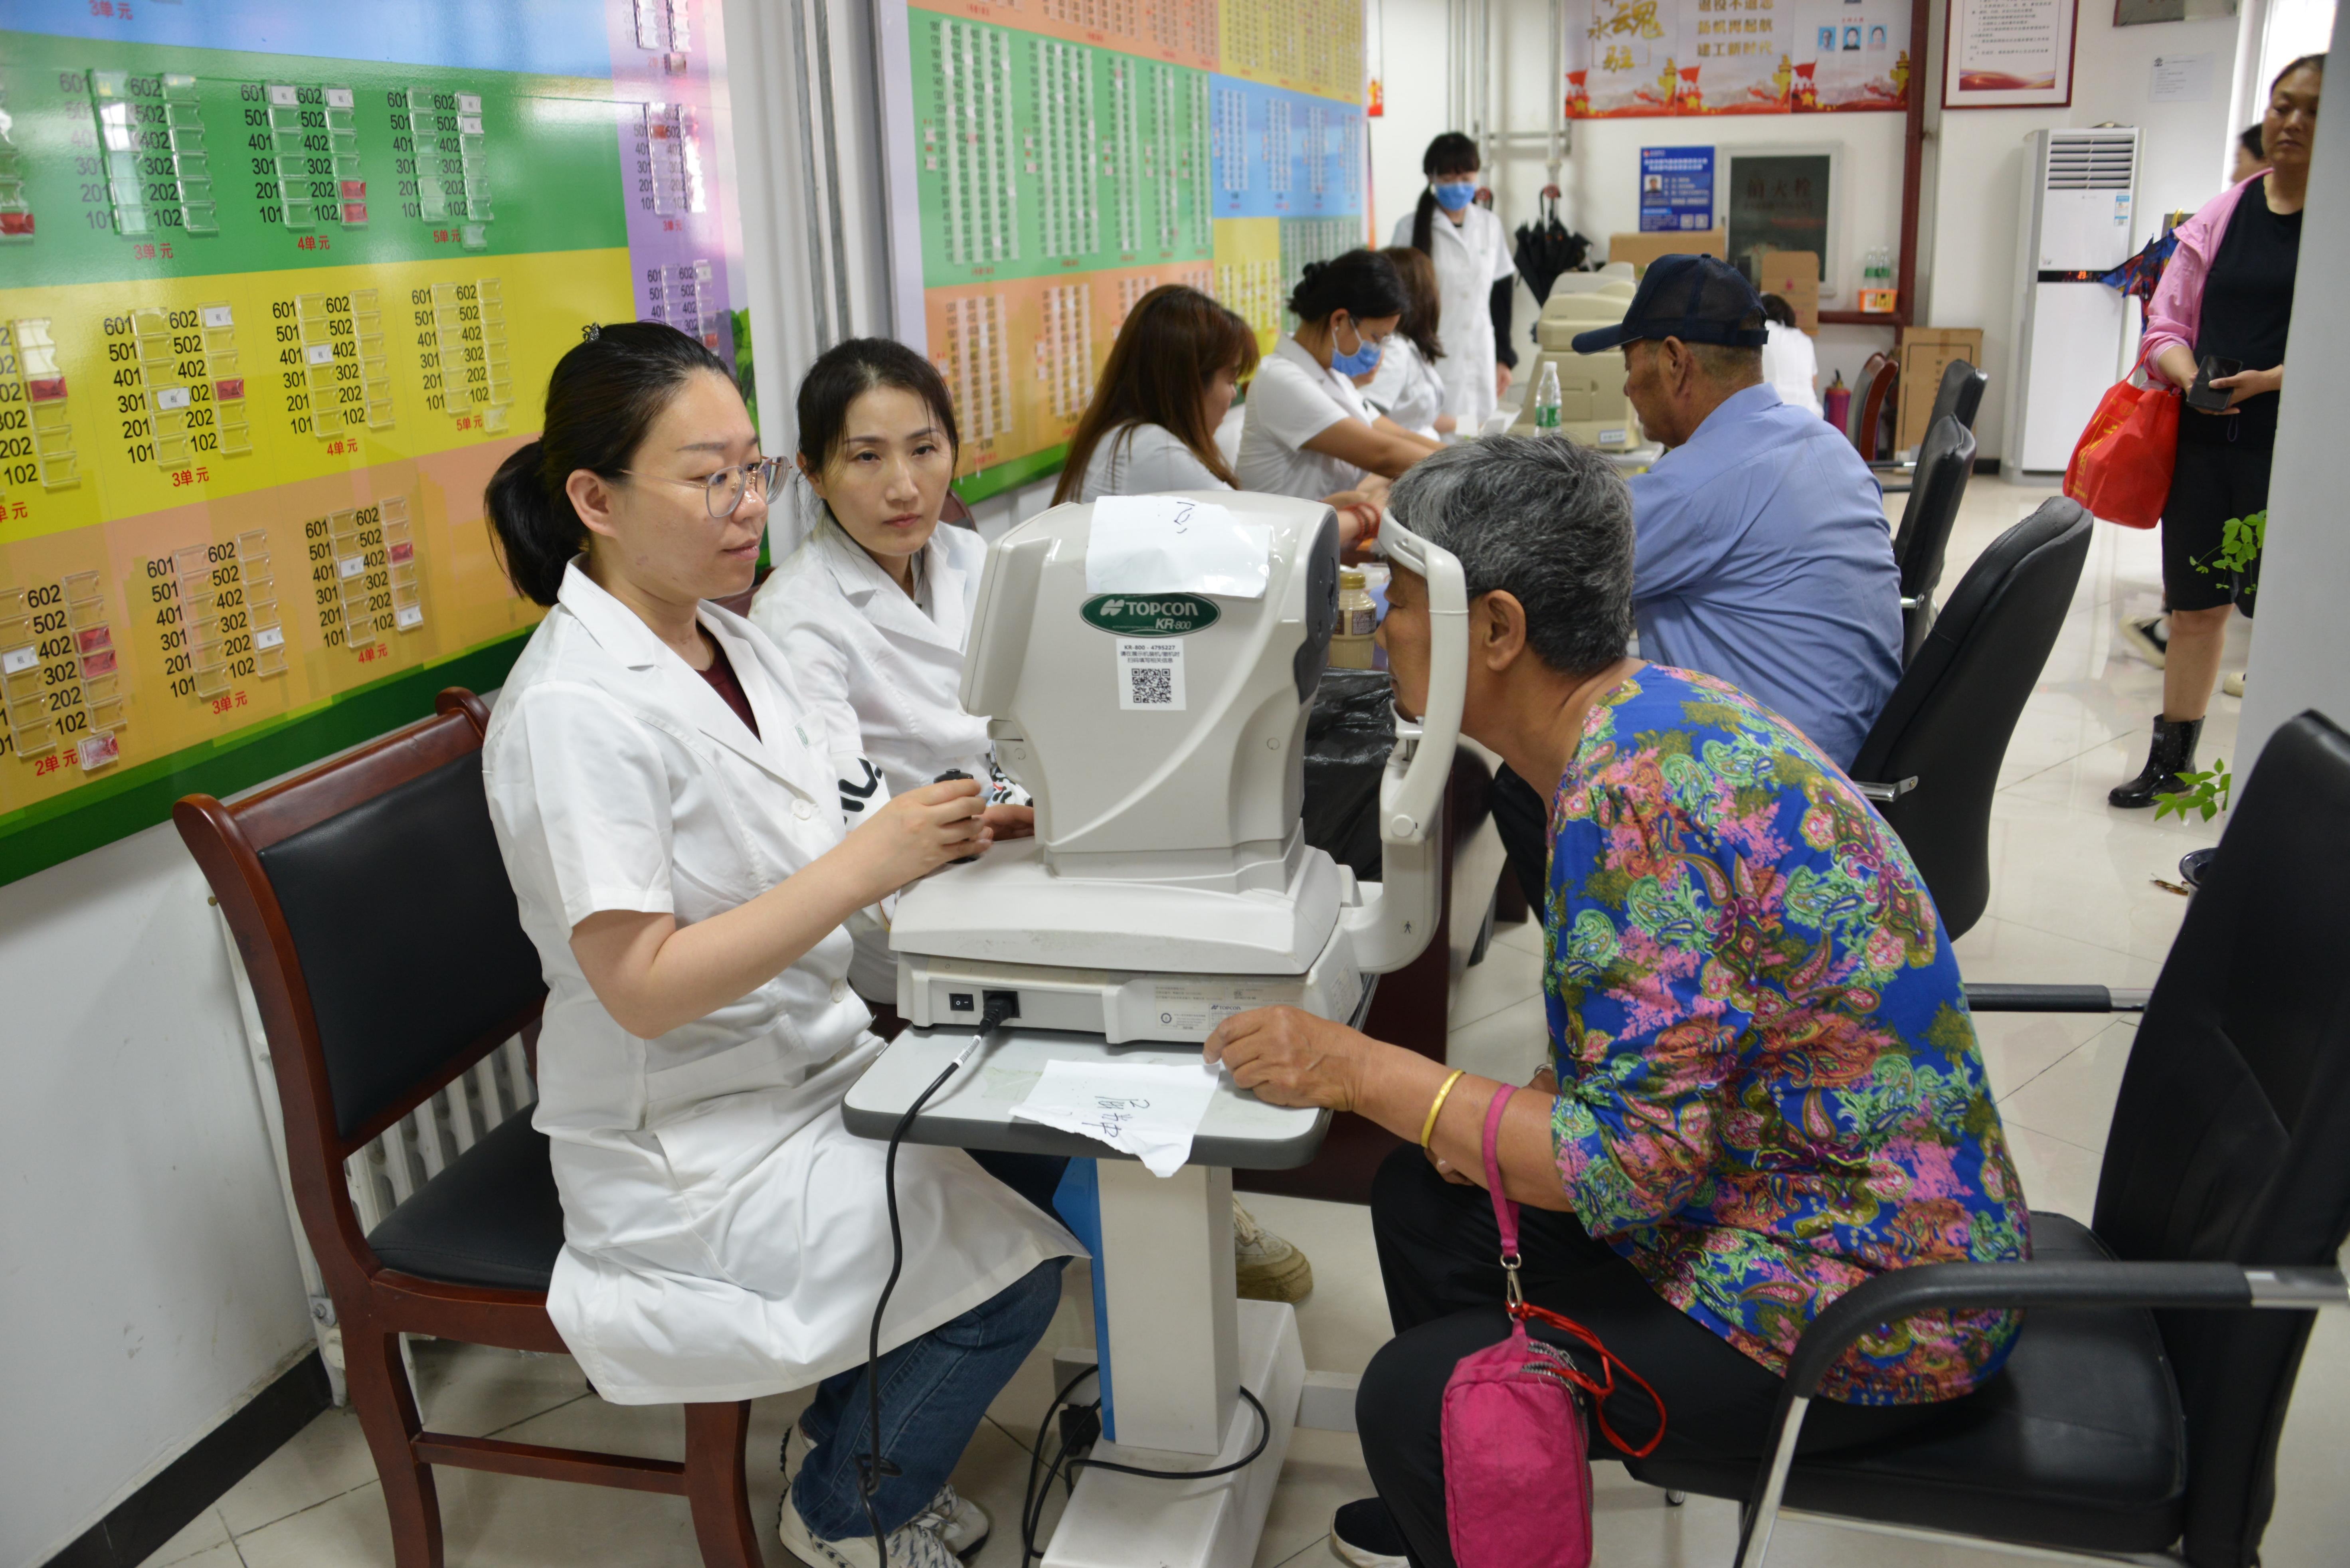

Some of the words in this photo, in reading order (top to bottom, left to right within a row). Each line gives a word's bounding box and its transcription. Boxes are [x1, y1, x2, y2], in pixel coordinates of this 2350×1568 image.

[131, 78, 162, 97] 602
[241, 85, 266, 102] 601
[297, 88, 323, 104] 602
[388, 92, 409, 107] 601
[434, 95, 455, 110] 602
[135, 105, 166, 123] 502
[245, 109, 270, 126] 501
[301, 112, 326, 128] 502
[391, 115, 411, 130] 501
[437, 117, 457, 131] 502
[140, 132, 170, 149] 402
[249, 134, 273, 150] 401
[304, 135, 329, 151] 402
[393, 137, 414, 152] 401
[440, 138, 460, 152] 402
[145, 157, 174, 175] 302
[252, 158, 277, 174] 301
[307, 158, 332, 174] 302
[396, 159, 417, 174] 301
[442, 159, 463, 174] 302
[149, 184, 178, 201] 202
[255, 182, 280, 199] 201
[311, 182, 335, 198] 202
[398, 181, 419, 196] 201
[445, 180, 465, 195] 202
[154, 209, 182, 226] 102
[259, 206, 283, 223] 101
[315, 205, 338, 221] 102
[402, 202, 421, 218] 101
[448, 202, 467, 216] 102
[297, 235, 329, 251] 4单元
[433, 229, 460, 243] 5单元
[134, 243, 173, 260] 3单元
[679, 268, 693, 279] 602
[412, 289, 432, 305] 601
[457, 285, 477, 300] 602
[681, 285, 695, 297] 502
[273, 301, 297, 319] 601
[326, 297, 350, 313] 602
[415, 310, 434, 326] 501
[459, 305, 479, 321] 502
[682, 303, 696, 313] 402
[104, 315, 134, 336] 601
[169, 310, 198, 329] 602
[276, 324, 300, 342] 501
[330, 319, 353, 336] 502
[417, 332, 437, 347] 401
[462, 326, 482, 341] 402
[109, 342, 138, 362] 501
[174, 335, 202, 354] 502
[279, 348, 303, 365] 401
[332, 341, 356, 358] 402
[420, 353, 440, 368] 301
[464, 346, 484, 362] 302
[113, 368, 142, 387] 401
[178, 360, 206, 378] 402
[283, 370, 307, 388] 301
[336, 364, 359, 380] 302
[423, 374, 442, 390] 201
[467, 367, 486, 382] 202
[118, 393, 146, 413] 301
[188, 384, 210, 403] 02
[287, 393, 310, 411] 201
[339, 386, 362, 403] 202
[426, 395, 445, 411] 101
[469, 387, 489, 403] 102
[123, 419, 150, 439] 201
[186, 409, 214, 428] 202
[291, 416, 313, 434] 101
[343, 408, 365, 425] 102
[456, 416, 483, 431] 5单元
[128, 443, 155, 463] 101
[190, 433, 218, 452] 102
[327, 439, 358, 456] 4单元
[4, 464, 38, 485] 102
[172, 467, 209, 487] 3单元
[306, 519, 328, 538] 601
[356, 508, 379, 525] 602
[310, 542, 331, 560] 501
[360, 529, 382, 547] 502
[147, 557, 174, 578] 601
[208, 542, 235, 563] 602
[313, 564, 334, 582] 401
[364, 550, 385, 568] 402
[152, 581, 178, 602] 501
[212, 566, 239, 586] 502
[316, 585, 338, 604] 301
[366, 571, 388, 590] 302
[28, 585, 61, 608] 602
[156, 605, 183, 625] 401
[217, 589, 243, 609] 402
[320, 607, 341, 627] 201
[370, 592, 391, 611] 202
[1126, 602, 1199, 615] TOPCON
[34, 611, 67, 634] 502
[161, 629, 187, 651] 301
[221, 612, 247, 633] 302
[324, 629, 345, 647] 101
[373, 613, 394, 632] 102
[1155, 619, 1191, 629] KR-800
[39, 636, 72, 659] 402
[165, 653, 191, 675] 201
[225, 635, 251, 656] 202
[358, 644, 387, 663] 4单元
[44, 661, 77, 685] 302
[170, 676, 196, 698] 101
[229, 658, 255, 678] 102
[49, 686, 82, 711] 202
[212, 691, 247, 714] 3单元
[55, 711, 87, 735] 102
[34, 749, 79, 777] 2单元
